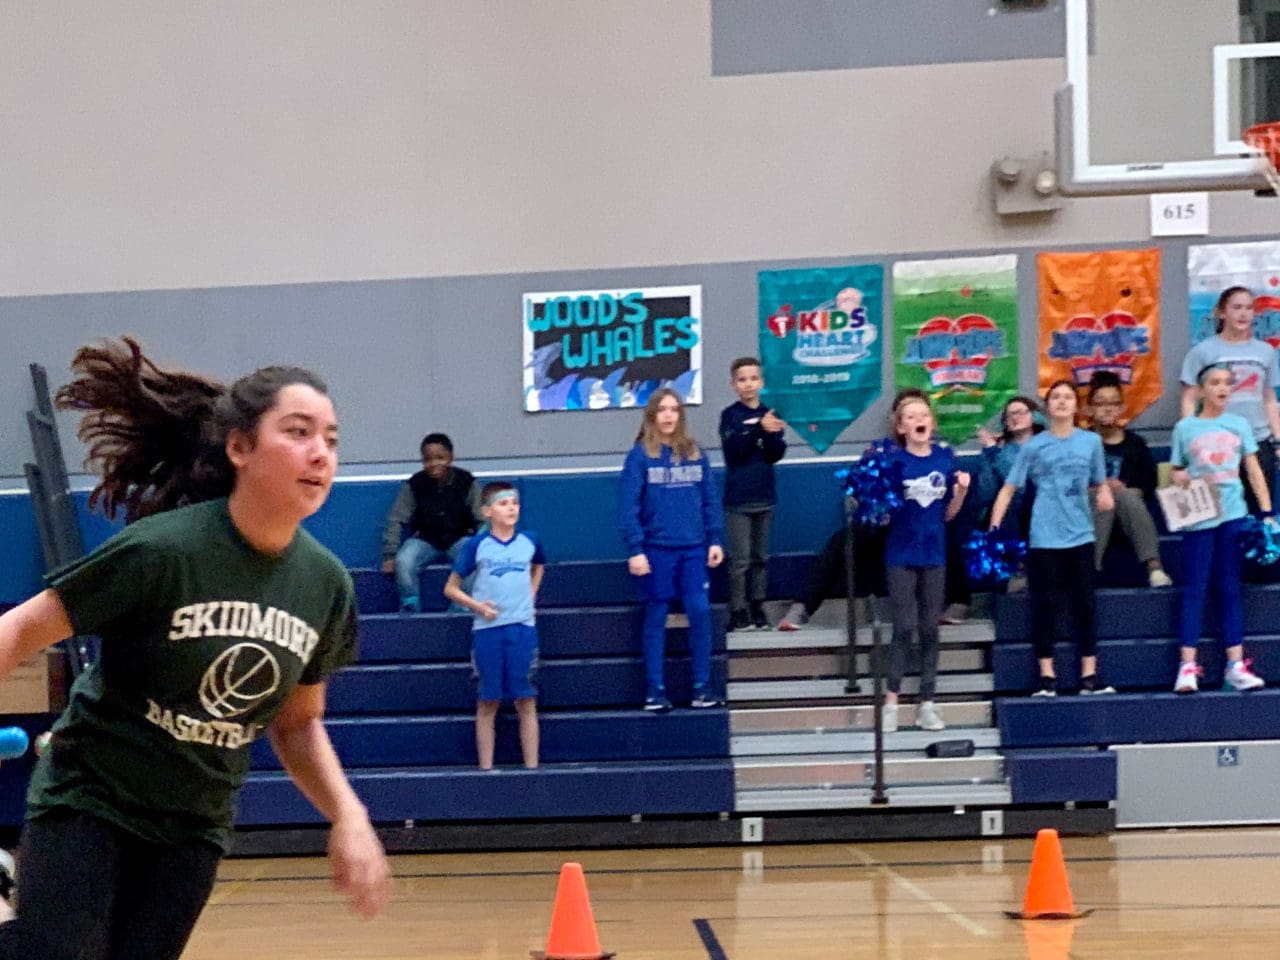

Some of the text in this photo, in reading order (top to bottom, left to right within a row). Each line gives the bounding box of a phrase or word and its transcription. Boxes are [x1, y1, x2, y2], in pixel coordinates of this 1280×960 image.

[1163, 203, 1195, 219] 615
[799, 307, 866, 332] KIDS
[562, 317, 699, 368] WHALES
[799, 328, 866, 348] HEART
